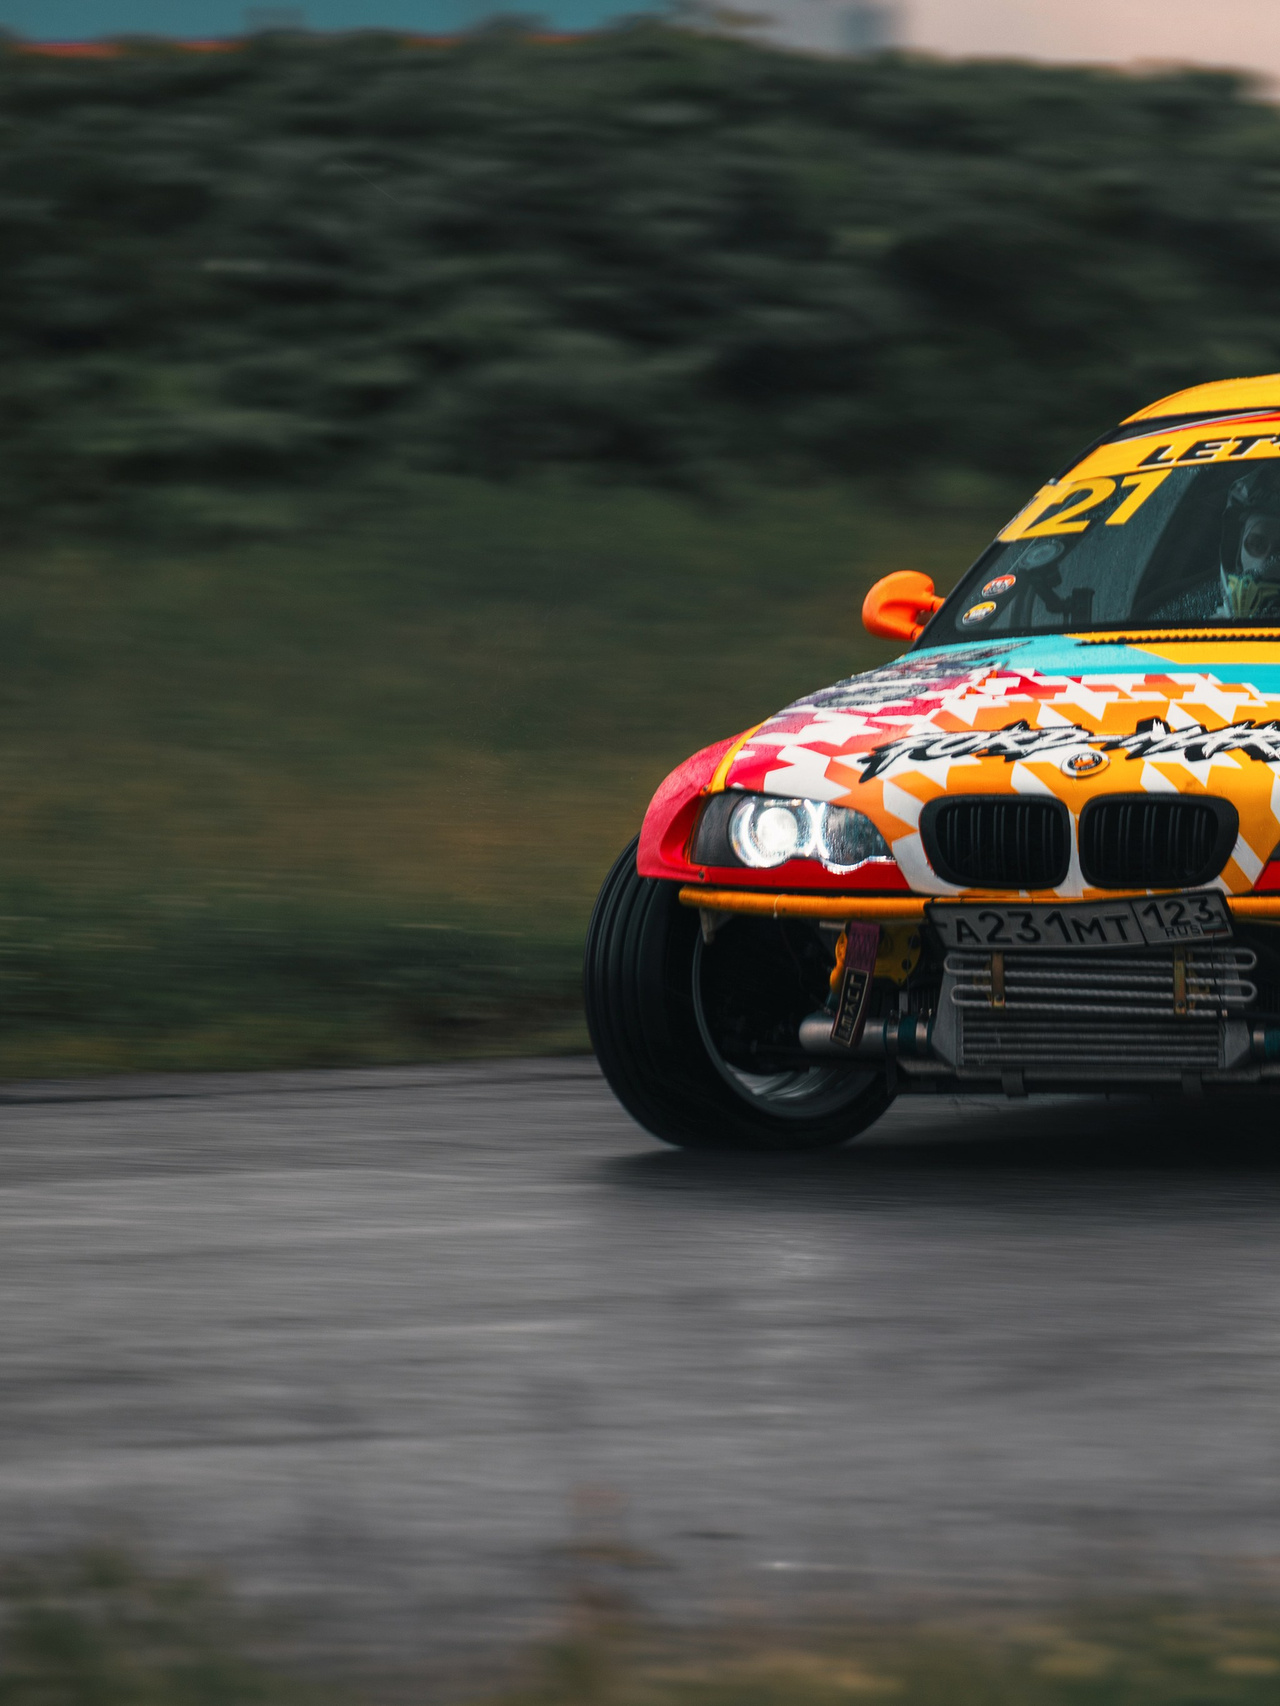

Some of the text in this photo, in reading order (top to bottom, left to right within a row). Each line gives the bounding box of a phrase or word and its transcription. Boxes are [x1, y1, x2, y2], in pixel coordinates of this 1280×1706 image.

[954, 909, 1130, 943] A231MT
[1142, 896, 1215, 928] 123
[1164, 924, 1200, 938] RUS
